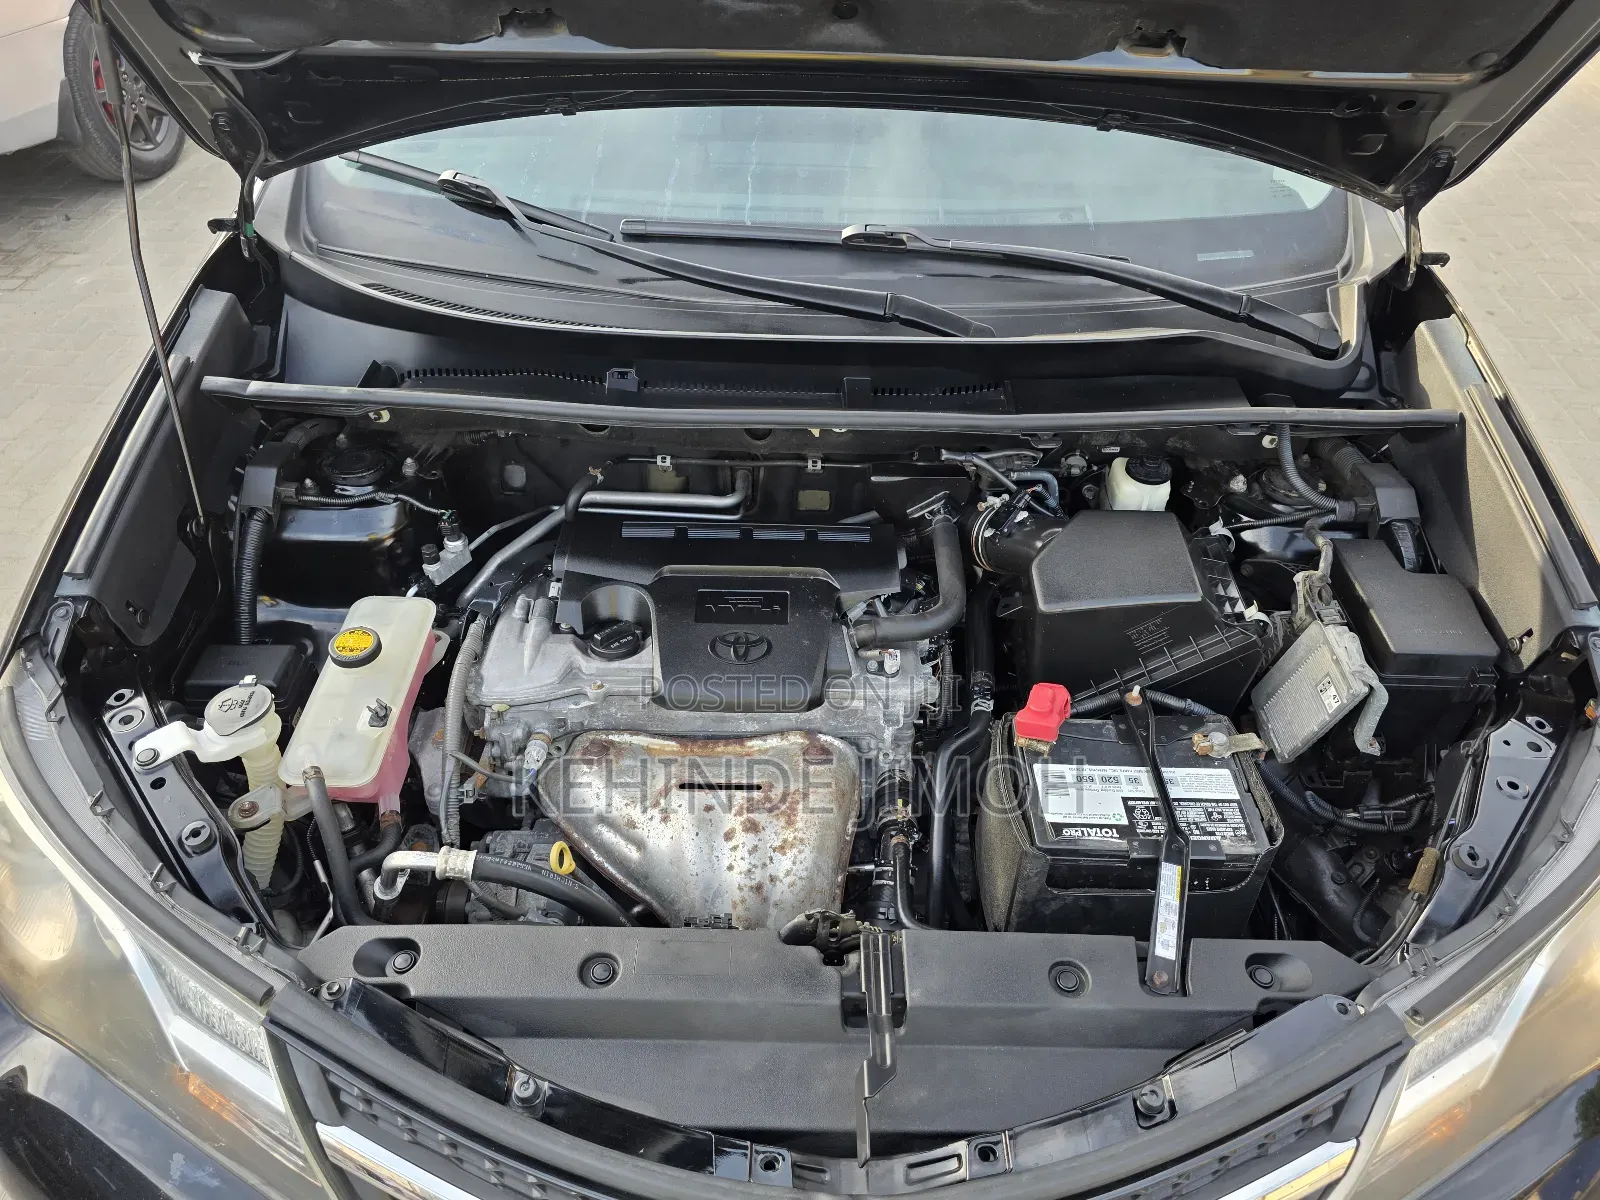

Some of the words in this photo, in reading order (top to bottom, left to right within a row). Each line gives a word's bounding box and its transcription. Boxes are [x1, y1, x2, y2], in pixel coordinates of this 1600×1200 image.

[1076, 775, 1095, 783] 650
[1101, 775, 1120, 784] 520
[1128, 777, 1140, 785] 35
[1062, 827, 1120, 838] TOTALPRO
